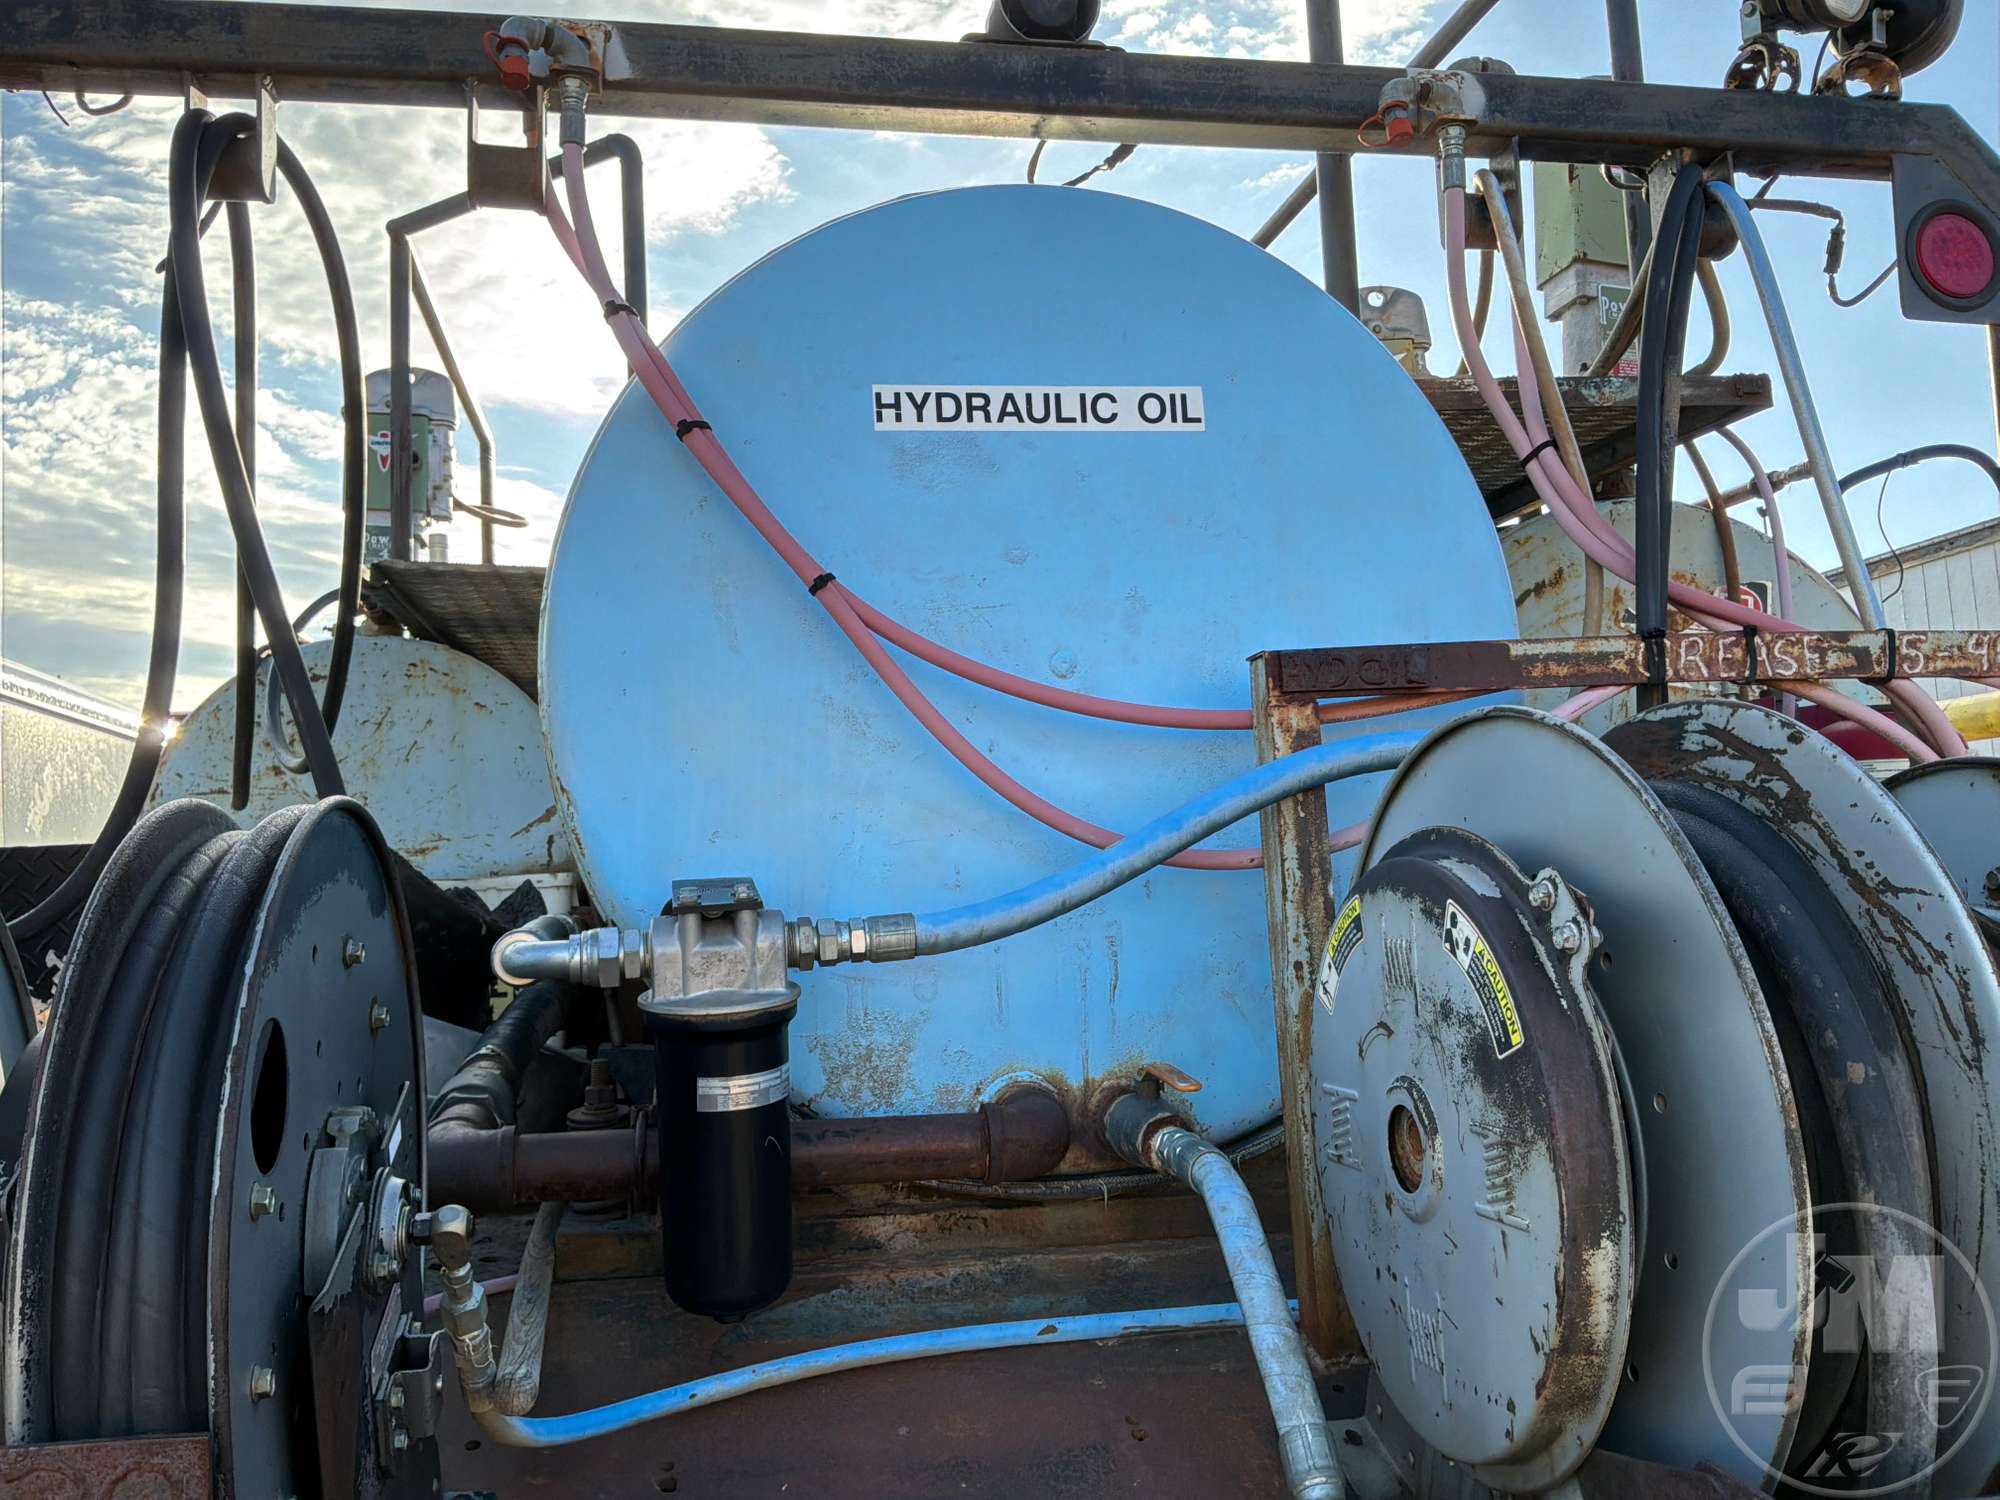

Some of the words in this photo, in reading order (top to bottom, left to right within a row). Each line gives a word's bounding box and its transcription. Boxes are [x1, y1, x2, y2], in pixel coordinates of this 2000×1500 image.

[874, 391, 1119, 424] HYDRAULIC
[1137, 392, 1202, 424] OIL
[1334, 902, 1358, 942] CAUTION
[1485, 958, 1518, 1036] CAUTION
